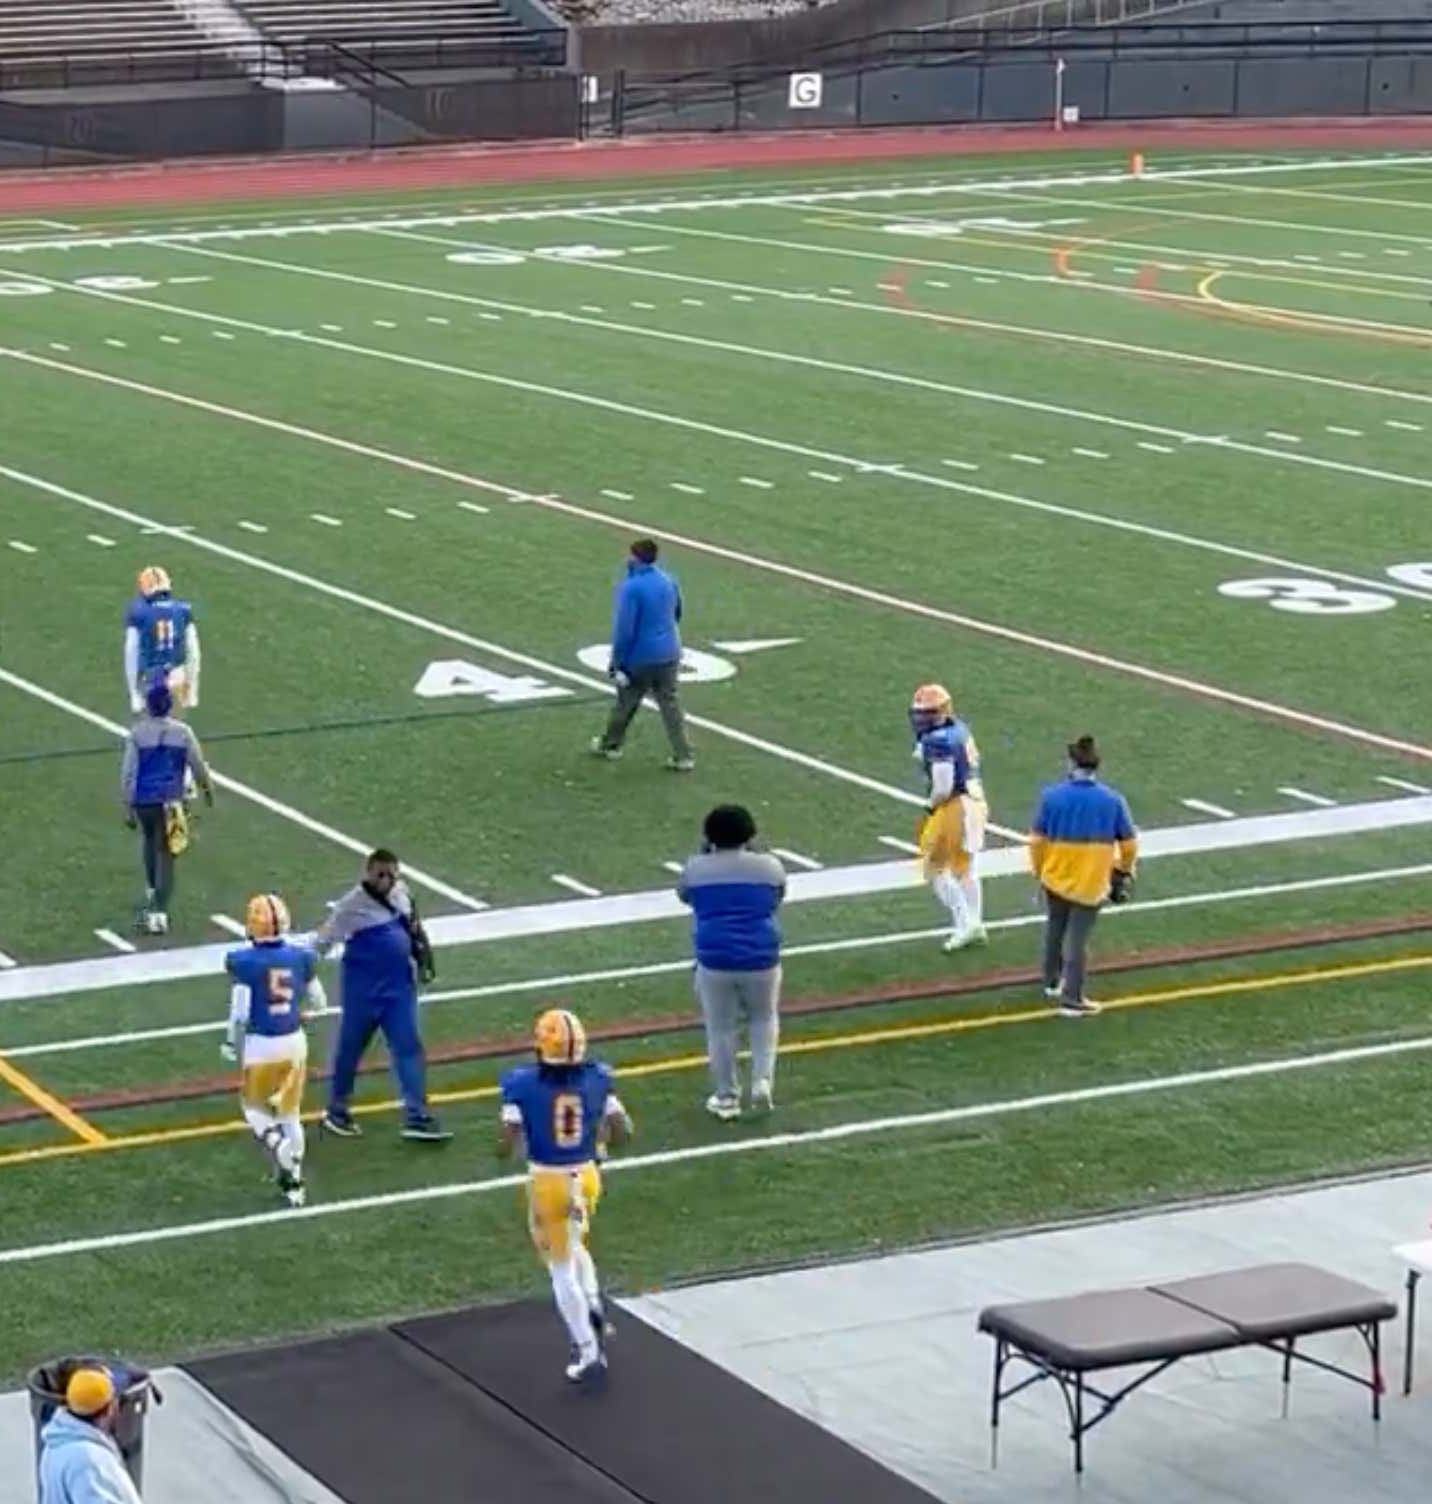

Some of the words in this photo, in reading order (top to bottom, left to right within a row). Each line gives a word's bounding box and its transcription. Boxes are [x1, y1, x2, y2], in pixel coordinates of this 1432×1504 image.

[795, 76, 817, 103] G
[267, 967, 294, 1013] 5
[554, 1093, 584, 1148] 0
